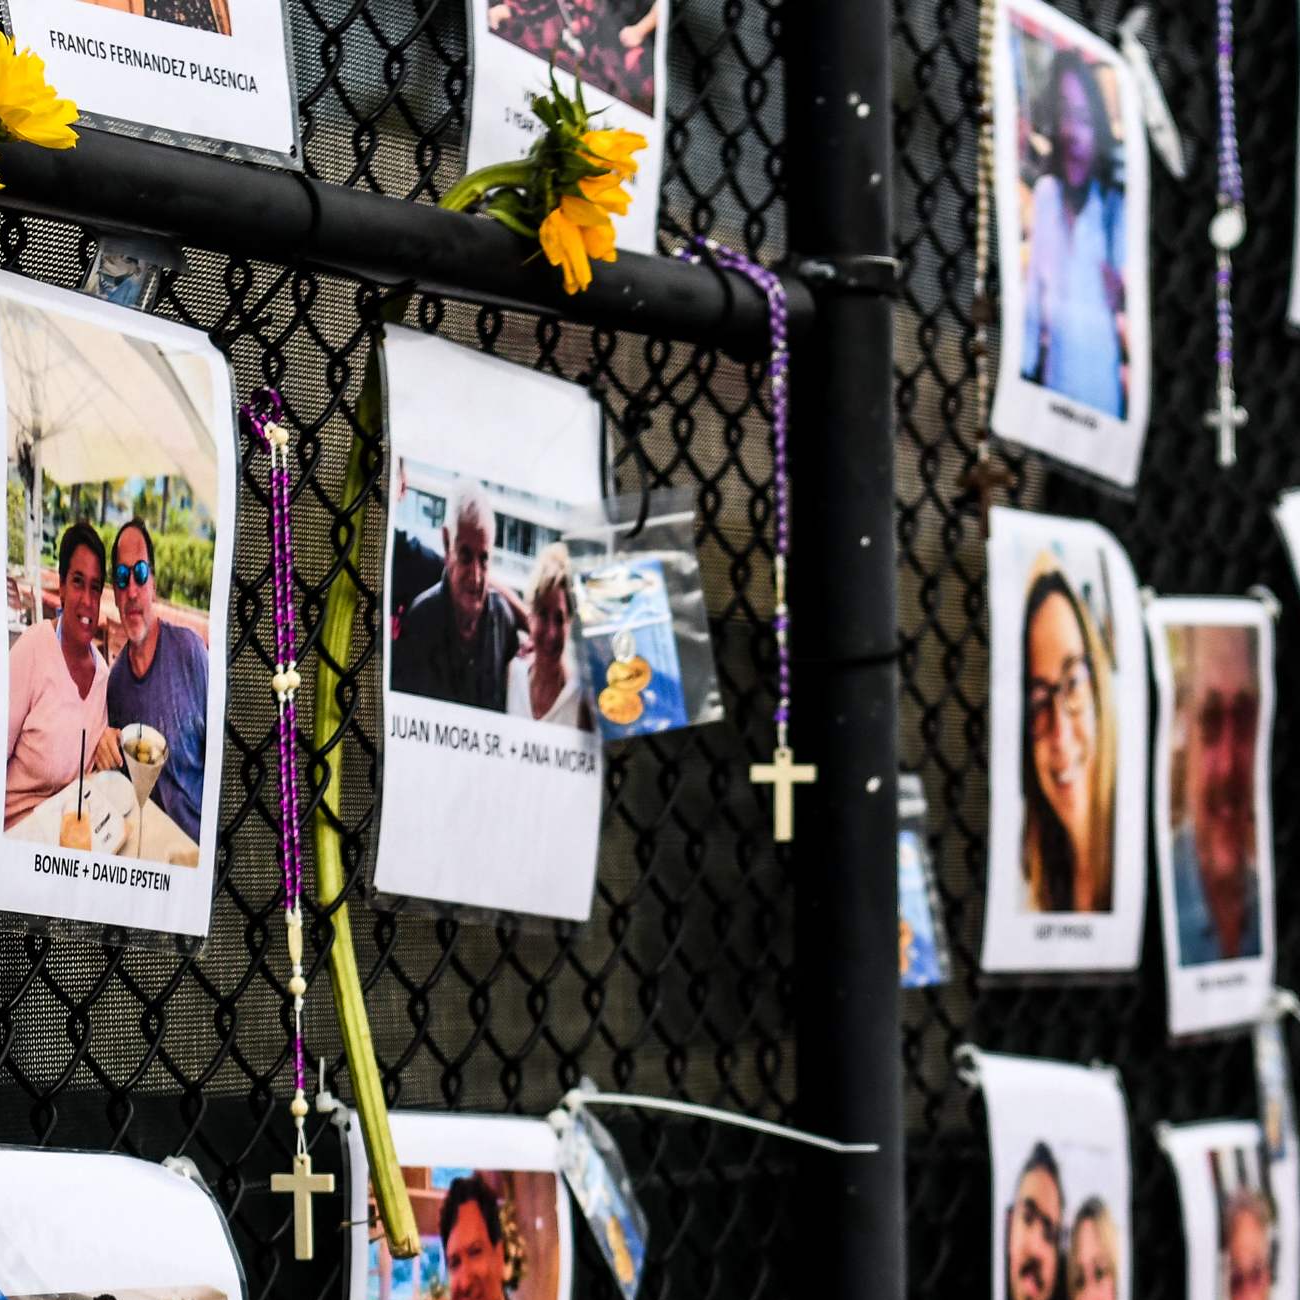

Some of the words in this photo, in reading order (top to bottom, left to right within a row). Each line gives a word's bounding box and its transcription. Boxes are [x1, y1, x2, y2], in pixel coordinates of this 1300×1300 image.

[49, 29, 108, 60] FRANCIS
[109, 43, 188, 79] FERNANDEZ
[189, 62, 259, 94] PLASENCIA
[390, 714, 430, 745] JUAN
[433, 723, 480, 752] MORA
[483, 733, 504, 759] SR.
[520, 740, 550, 766] ANA
[554, 749, 597, 775] MORA
[33, 853, 80, 878] BONNIE
[81, 866, 90, 879] +
[91, 862, 128, 885] DAVID
[129, 868, 171, 892] EPSTEIN
